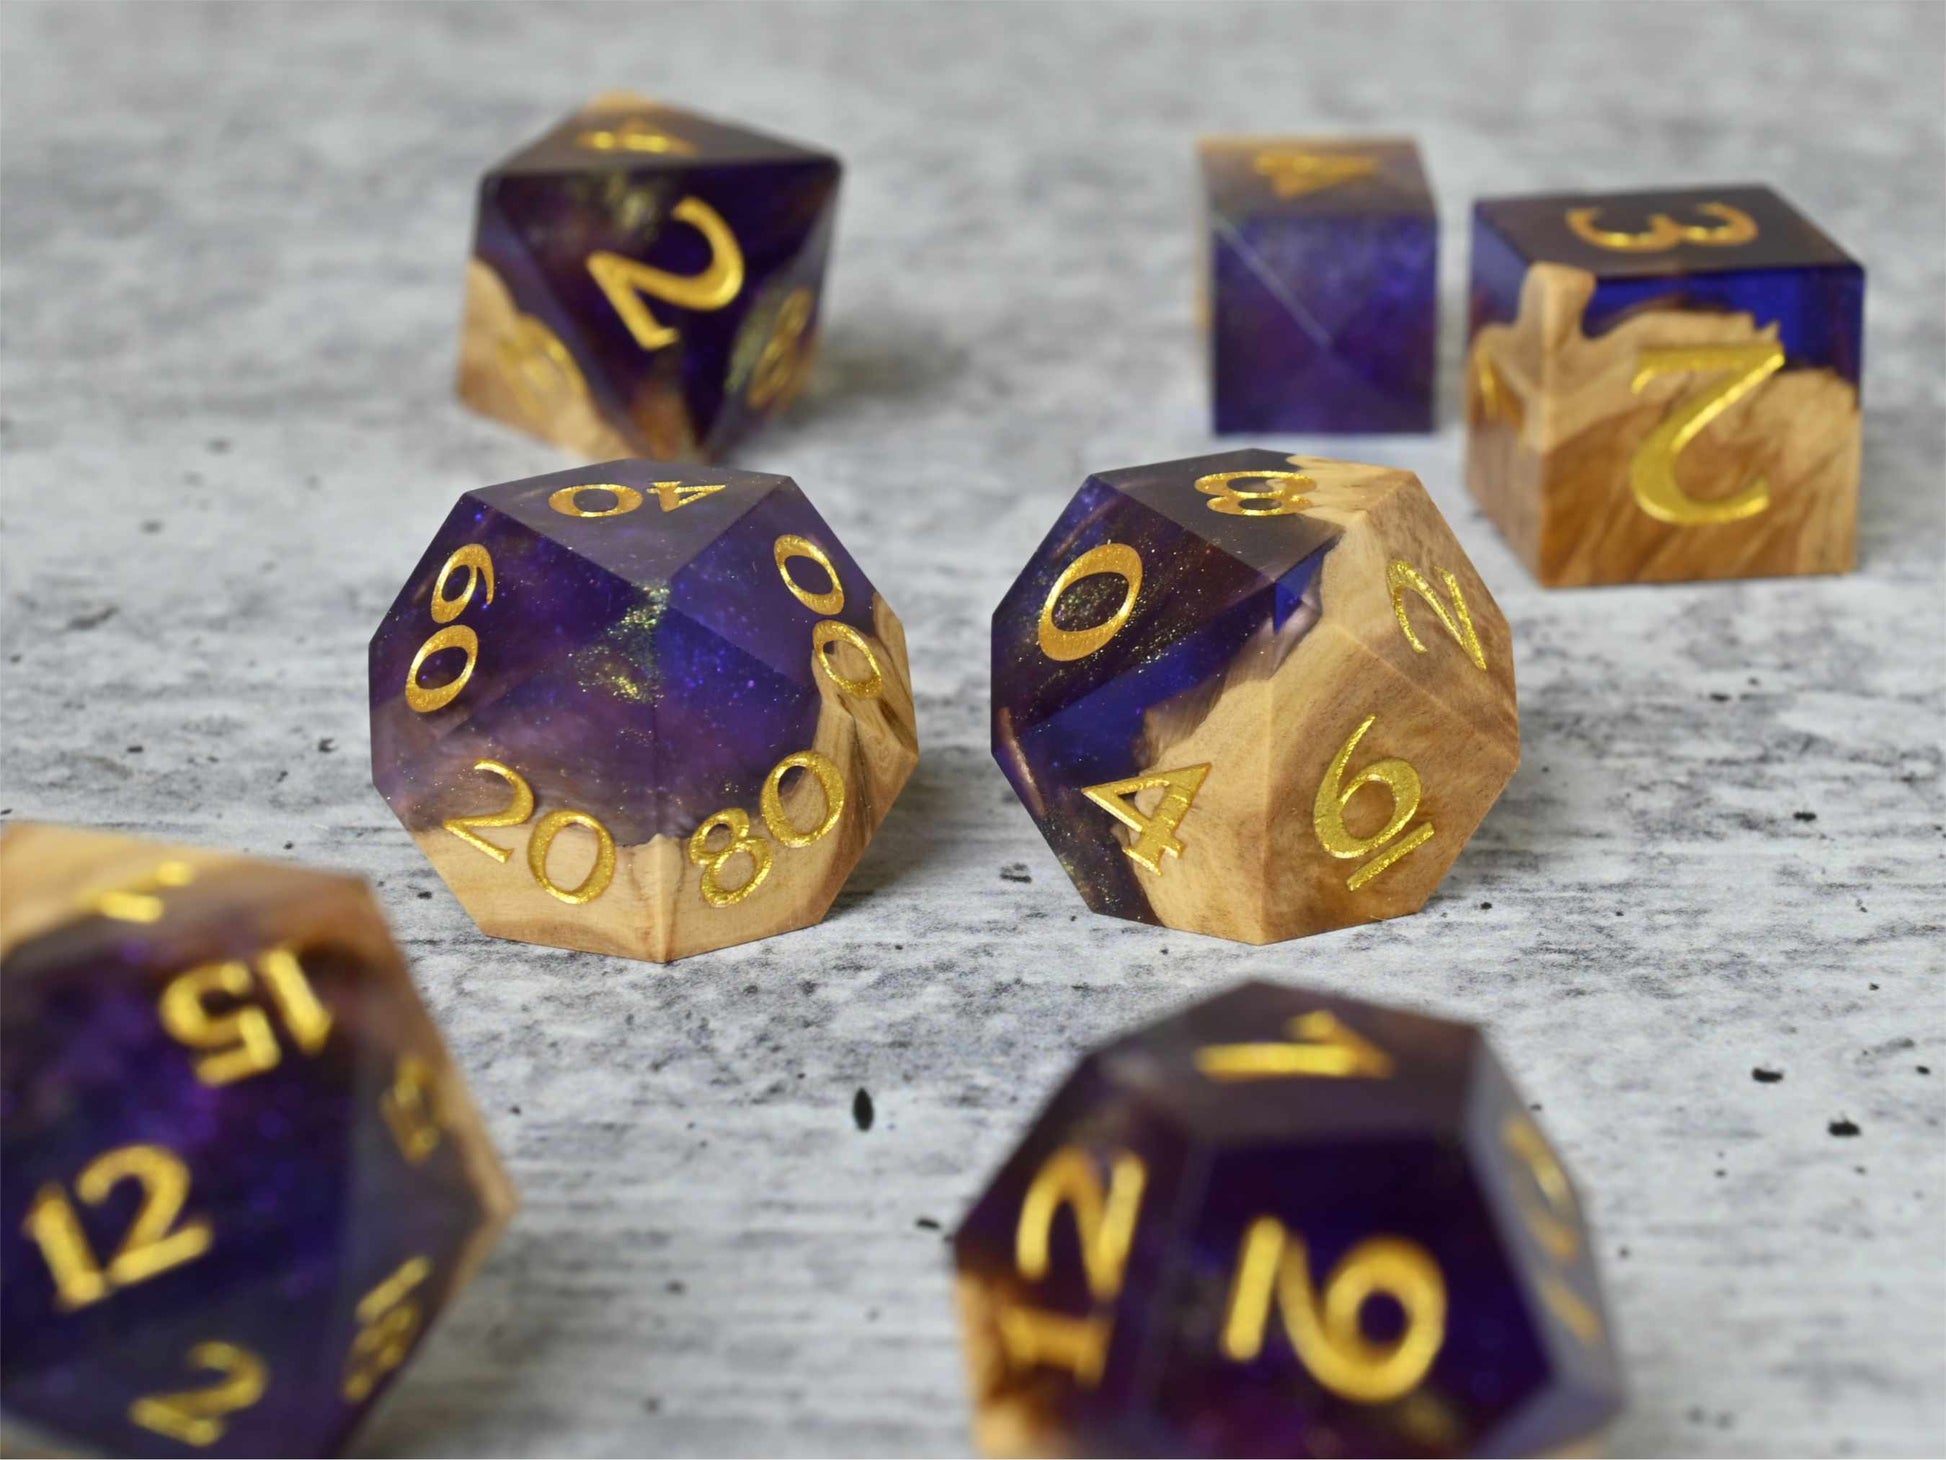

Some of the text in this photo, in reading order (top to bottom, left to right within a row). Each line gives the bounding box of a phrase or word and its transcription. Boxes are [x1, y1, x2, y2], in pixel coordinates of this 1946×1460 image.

[586, 195, 745, 351] 2
[1566, 201, 1758, 253] 3
[549, 480, 727, 517] 40
[1194, 470, 1318, 516] 8
[1630, 342, 1785, 526] 2
[773, 534, 883, 700] 00
[1038, 542, 1143, 662] 0
[1386, 559, 1488, 670] 2
[443, 757, 616, 905] 20
[689, 749, 846, 907] 80
[1081, 762, 1212, 876] 4
[1313, 715, 1435, 892] 6
[160, 947, 333, 1086] 15
[1195, 1008, 1395, 1081] 1
[23, 1143, 212, 1311] 12
[126, 1339, 270, 1448] 2
